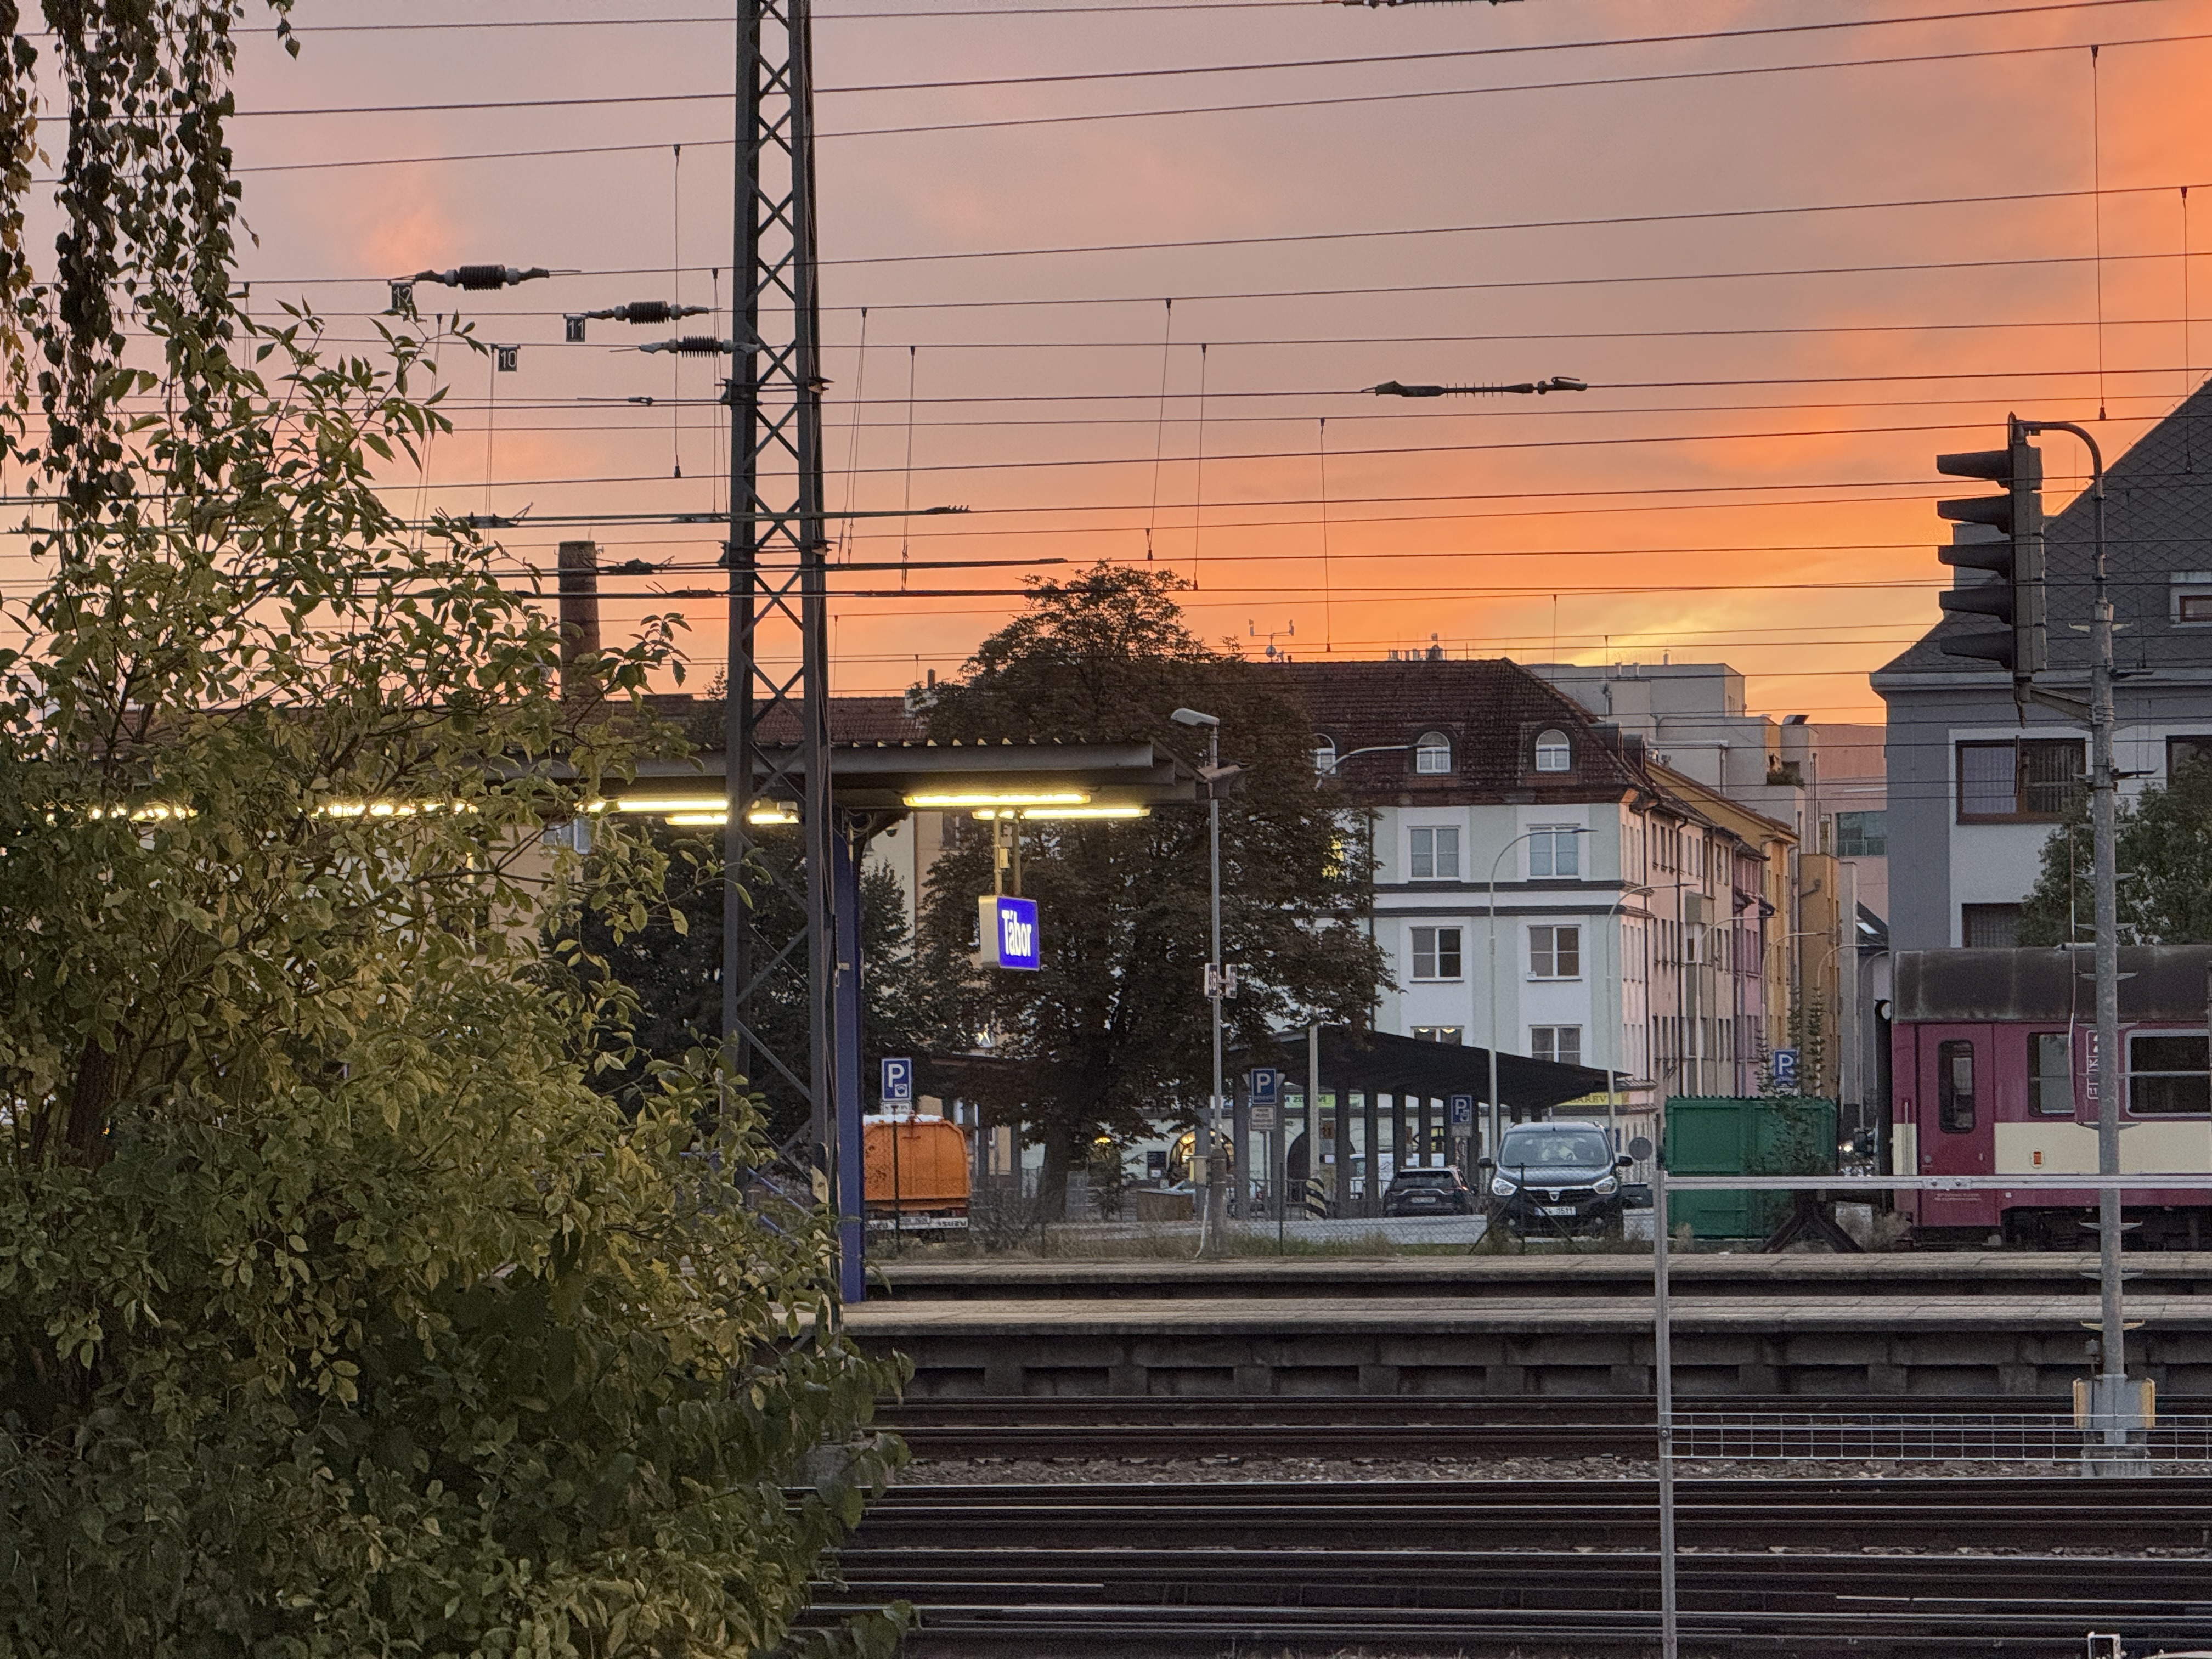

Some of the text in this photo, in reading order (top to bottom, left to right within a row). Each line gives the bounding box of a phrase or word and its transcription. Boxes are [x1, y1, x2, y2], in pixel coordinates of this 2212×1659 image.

[393, 286, 412, 307] 12
[568, 320, 584, 338] 11
[500, 351, 516, 368] 10
[1001, 909, 1032, 957] Tábor
[1778, 1054, 1794, 1075] P
[888, 1063, 905, 1088] P
[1256, 1073, 1272, 1093] P
[1455, 1098, 1467, 1116] P
